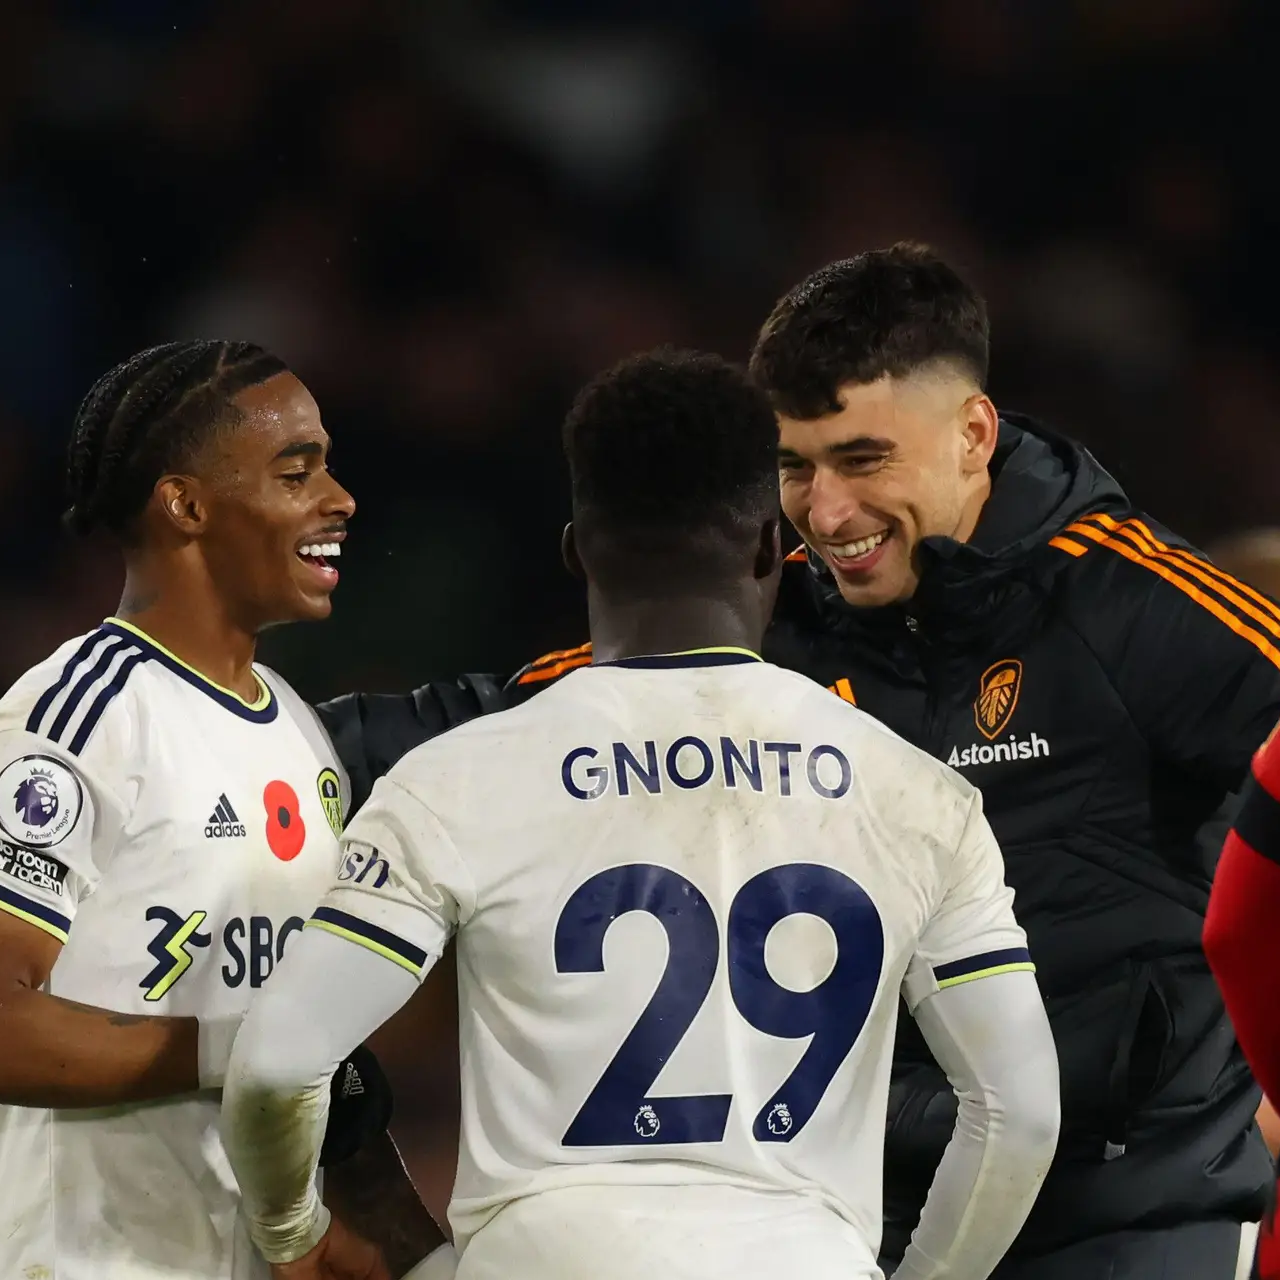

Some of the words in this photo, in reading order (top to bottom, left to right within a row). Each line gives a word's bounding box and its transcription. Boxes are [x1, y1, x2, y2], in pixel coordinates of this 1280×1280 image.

[947, 732, 1050, 768] Astonish
[561, 735, 853, 800] GNONTO
[26, 830, 53, 841] Premier
[51, 808, 70, 834] League
[204, 822, 247, 839] adidas
[10, 862, 63, 896] racism
[16, 849, 59, 878] room
[554, 861, 885, 1147] 29
